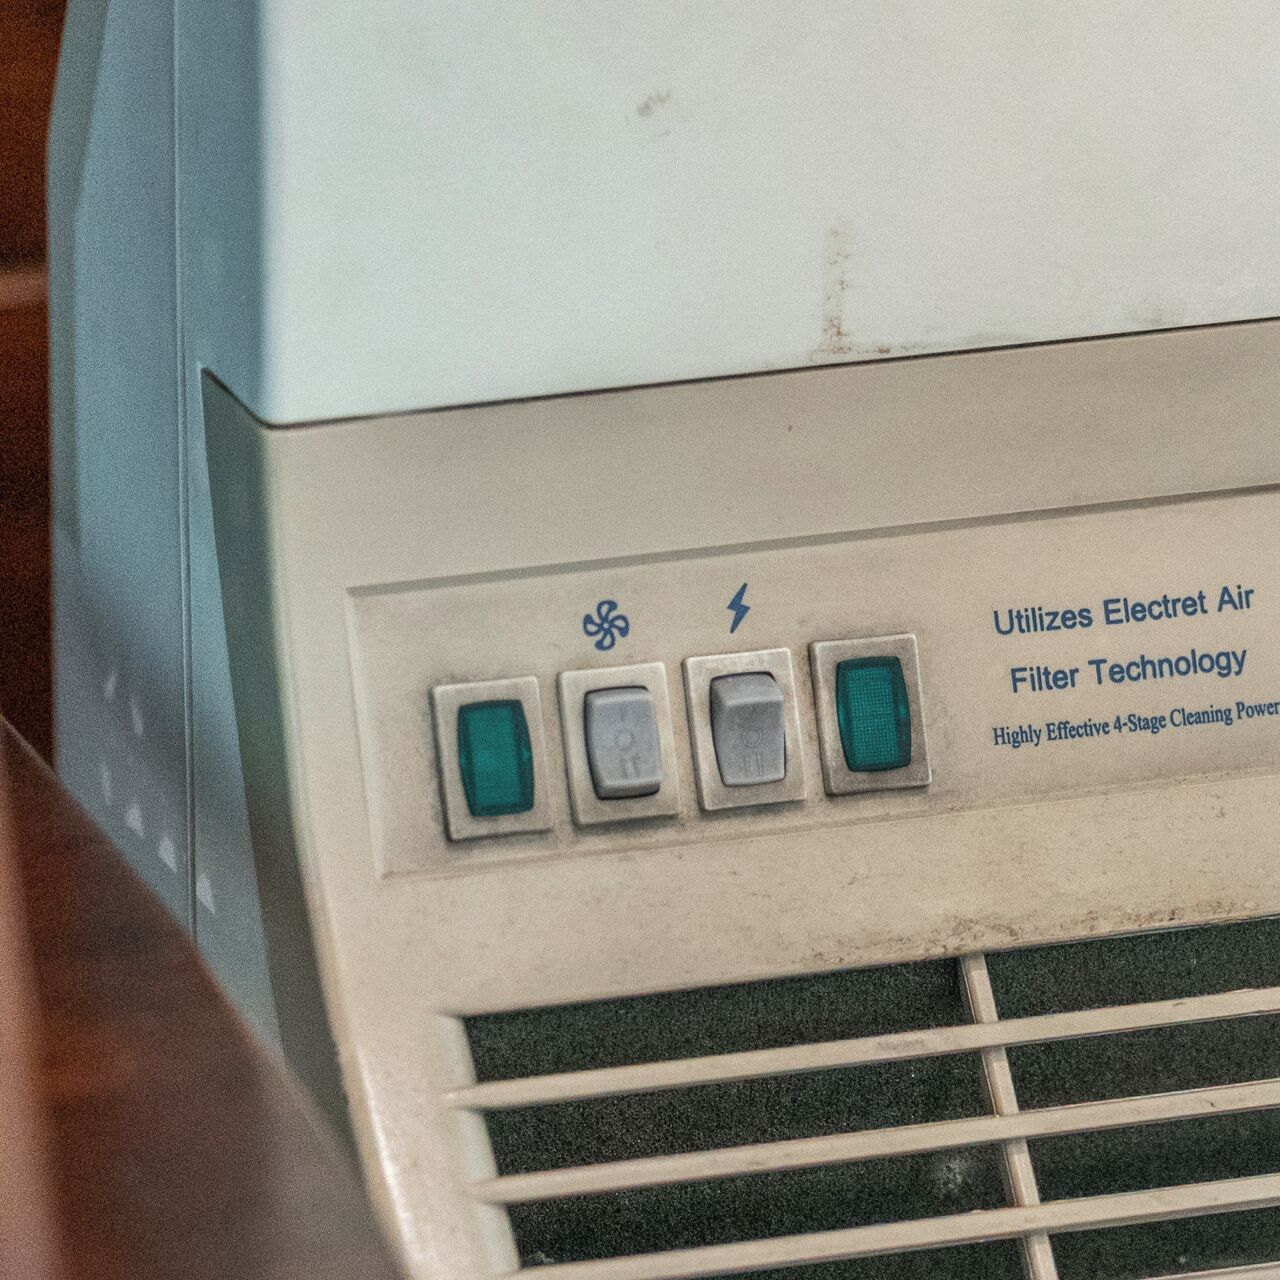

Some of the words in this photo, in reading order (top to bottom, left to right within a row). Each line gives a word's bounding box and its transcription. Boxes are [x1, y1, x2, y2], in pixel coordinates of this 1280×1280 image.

[993, 606, 1094, 636] Utilizes
[1103, 589, 1208, 625] Electret
[1217, 584, 1255, 613] Air
[1010, 666, 1079, 693] Filter
[1088, 648, 1247, 685] Technology
[992, 723, 1042, 749] Highly
[1046, 717, 1110, 741] Effective
[1113, 712, 1167, 734] 4-Stage
[1169, 703, 1234, 726] Cleaning
[1235, 699, 1280, 720] Power
